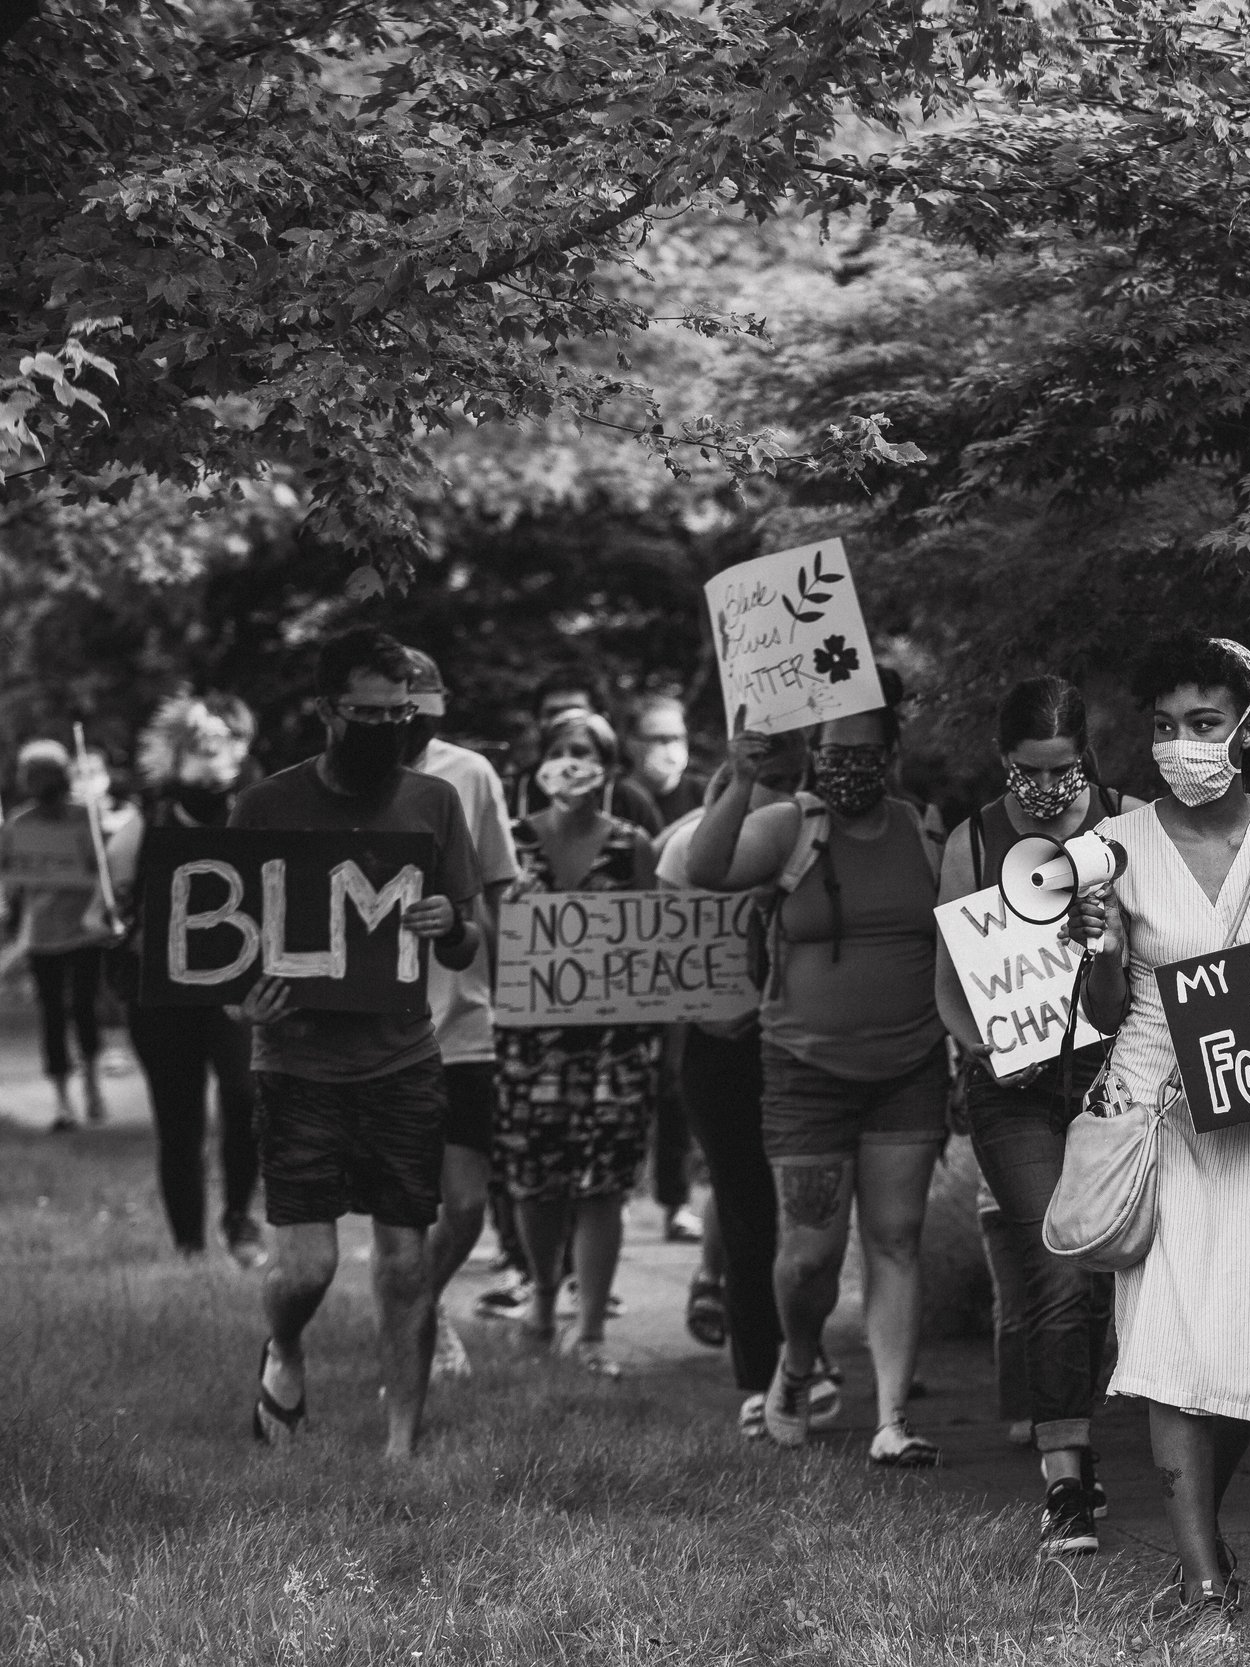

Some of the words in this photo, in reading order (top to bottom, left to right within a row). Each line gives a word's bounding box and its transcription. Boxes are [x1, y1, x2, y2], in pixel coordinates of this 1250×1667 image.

[168, 857, 424, 985] BLM
[529, 901, 589, 955] NO
[606, 895, 749, 945] JUSTIC
[960, 894, 1007, 938] W
[529, 957, 588, 1013] NO
[603, 942, 728, 1000] PEACE
[969, 940, 1074, 1000] WAN
[1176, 960, 1228, 1003] MY
[986, 995, 1089, 1054] CHA
